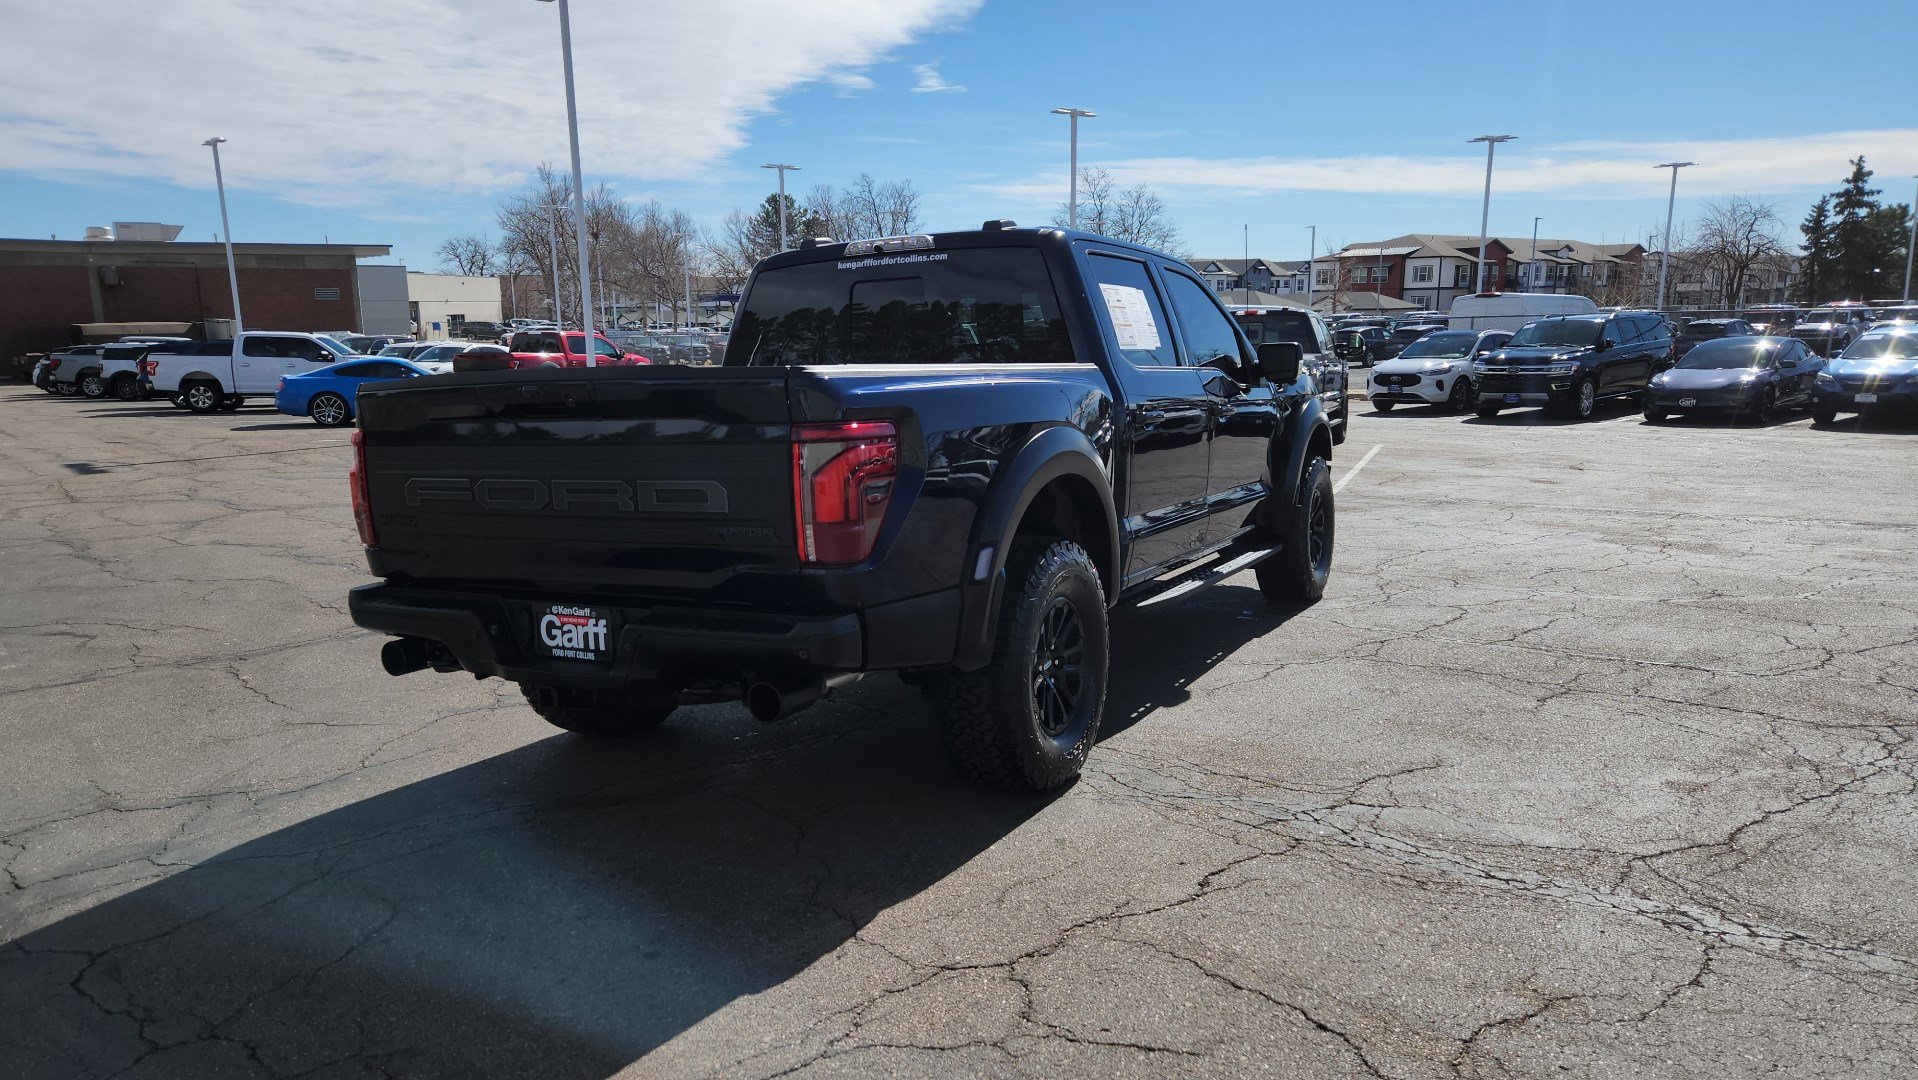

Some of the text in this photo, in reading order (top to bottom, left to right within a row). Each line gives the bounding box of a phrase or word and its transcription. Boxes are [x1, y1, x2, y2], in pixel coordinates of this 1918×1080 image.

[837, 253, 948, 270] kengarfffordfortcollins.com
[404, 477, 729, 514] FORD
[540, 614, 607, 651] Garff
[552, 648, 565, 657] FORD
[565, 649, 576, 658] FORT
